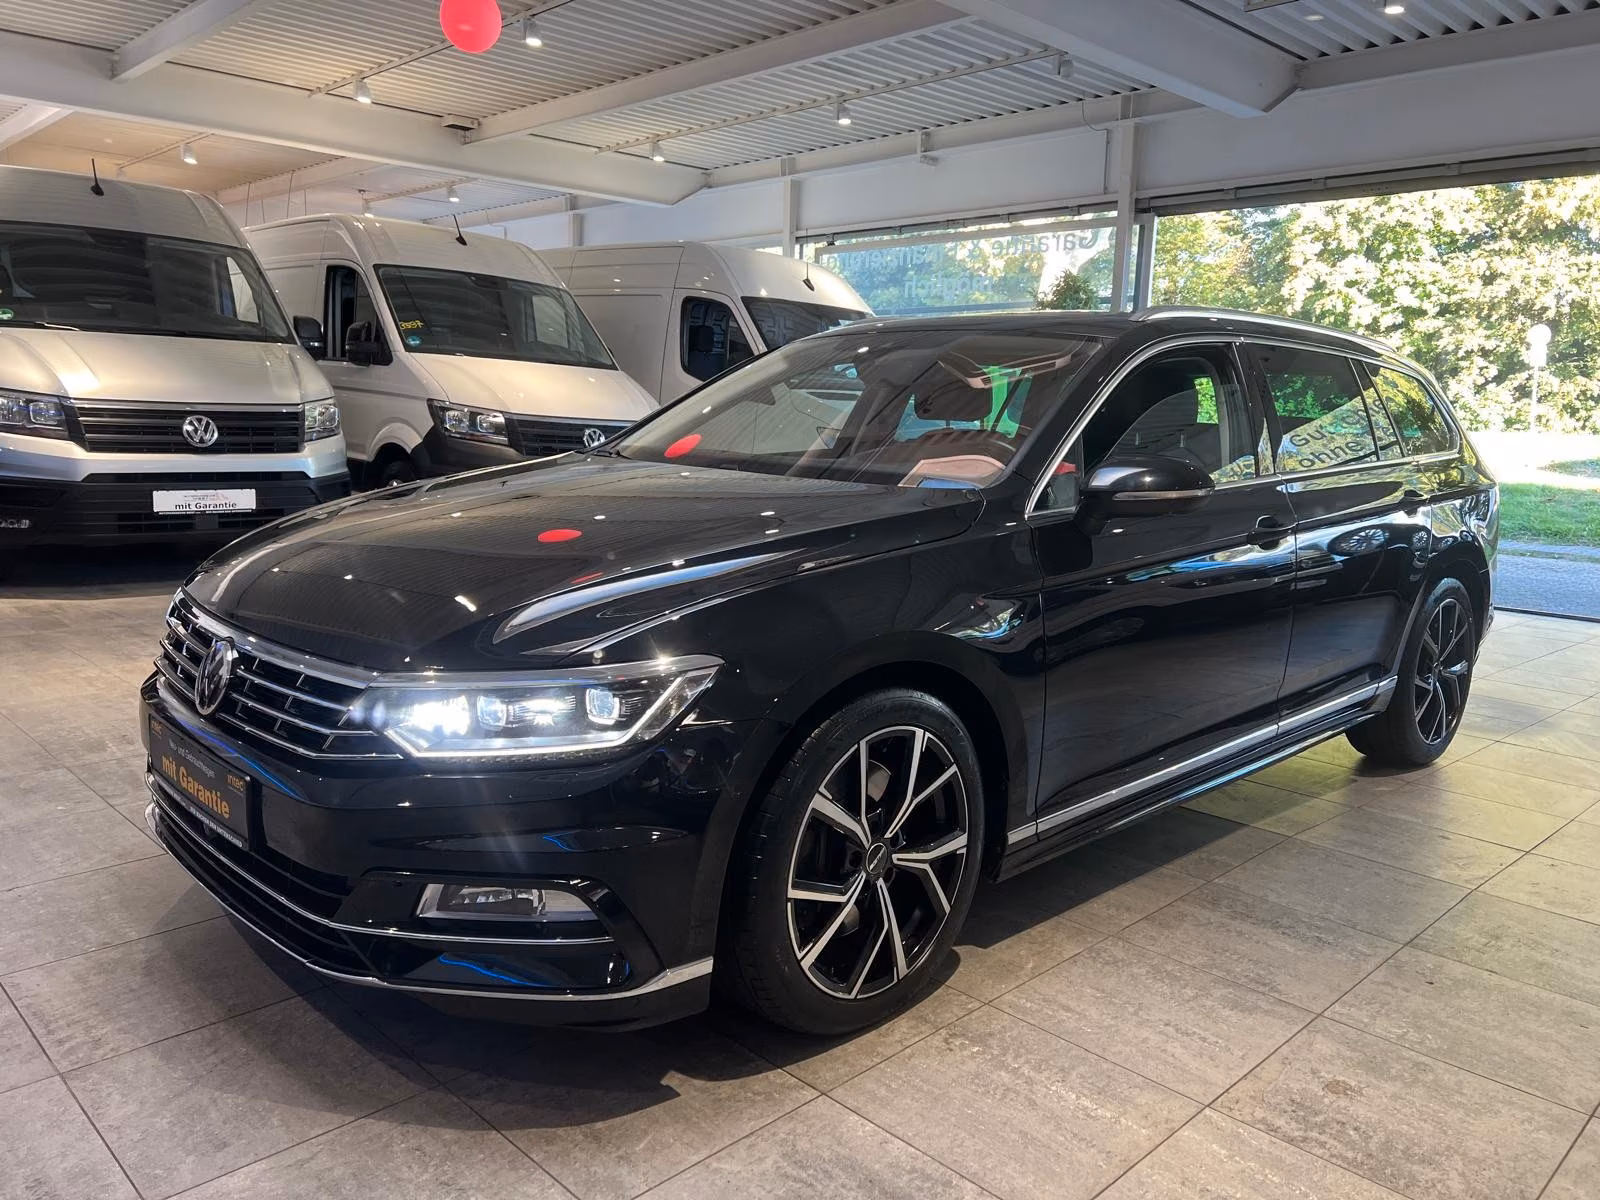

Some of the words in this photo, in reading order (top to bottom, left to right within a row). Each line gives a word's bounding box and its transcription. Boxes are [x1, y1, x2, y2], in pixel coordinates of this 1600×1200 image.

[1298, 440, 1364, 469] ohne
[174, 502, 191, 510] mit
[195, 501, 237, 510] Garantie
[162, 755, 177, 781] mit
[179, 766, 230, 819] Garantie
